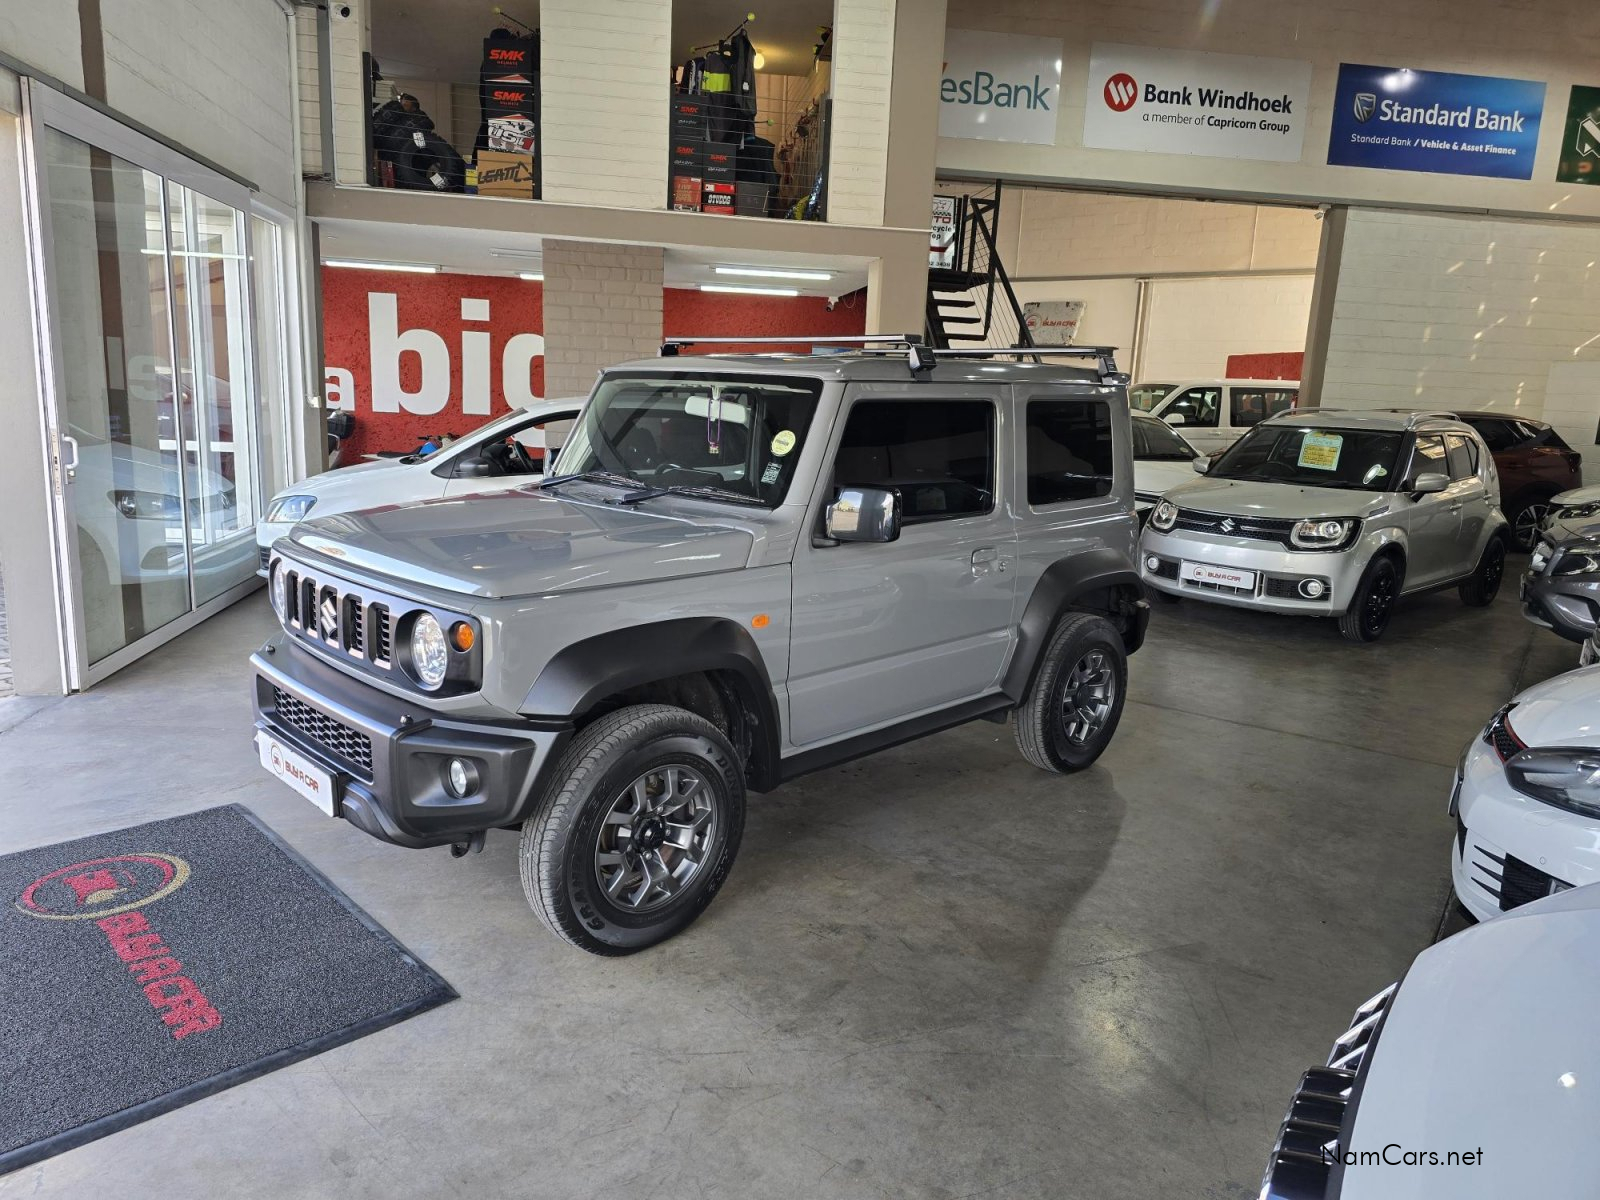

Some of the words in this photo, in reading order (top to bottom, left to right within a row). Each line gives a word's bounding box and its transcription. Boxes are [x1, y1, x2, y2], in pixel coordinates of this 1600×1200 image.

[489, 49, 525, 61] SMK
[493, 90, 526, 102] SMK
[940, 68, 1050, 111] esBank
[1143, 83, 1193, 106] Bank
[1198, 87, 1292, 114] Windhoek
[1142, 113, 1149, 122] a
[1151, 112, 1193, 125] member
[1194, 115, 1206, 126] of
[1207, 115, 1257, 130] Capricorn
[1259, 119, 1290, 135] Group
[1379, 99, 1470, 128] Standard
[1474, 107, 1525, 133] Bank
[1350, 133, 1390, 145] Standard
[1391, 136, 1412, 147] Bank
[1420, 138, 1451, 150] Vehicle
[1451, 141, 1459, 151] &
[1460, 142, 1484, 153] Asset
[1484, 144, 1517, 156] Finance
[932, 215, 951, 223] TO
[1207, 571, 1221, 580] BUY
[1227, 575, 1241, 583] CAR
[285, 760, 299, 779] BUY
[305, 774, 319, 793] CAR
